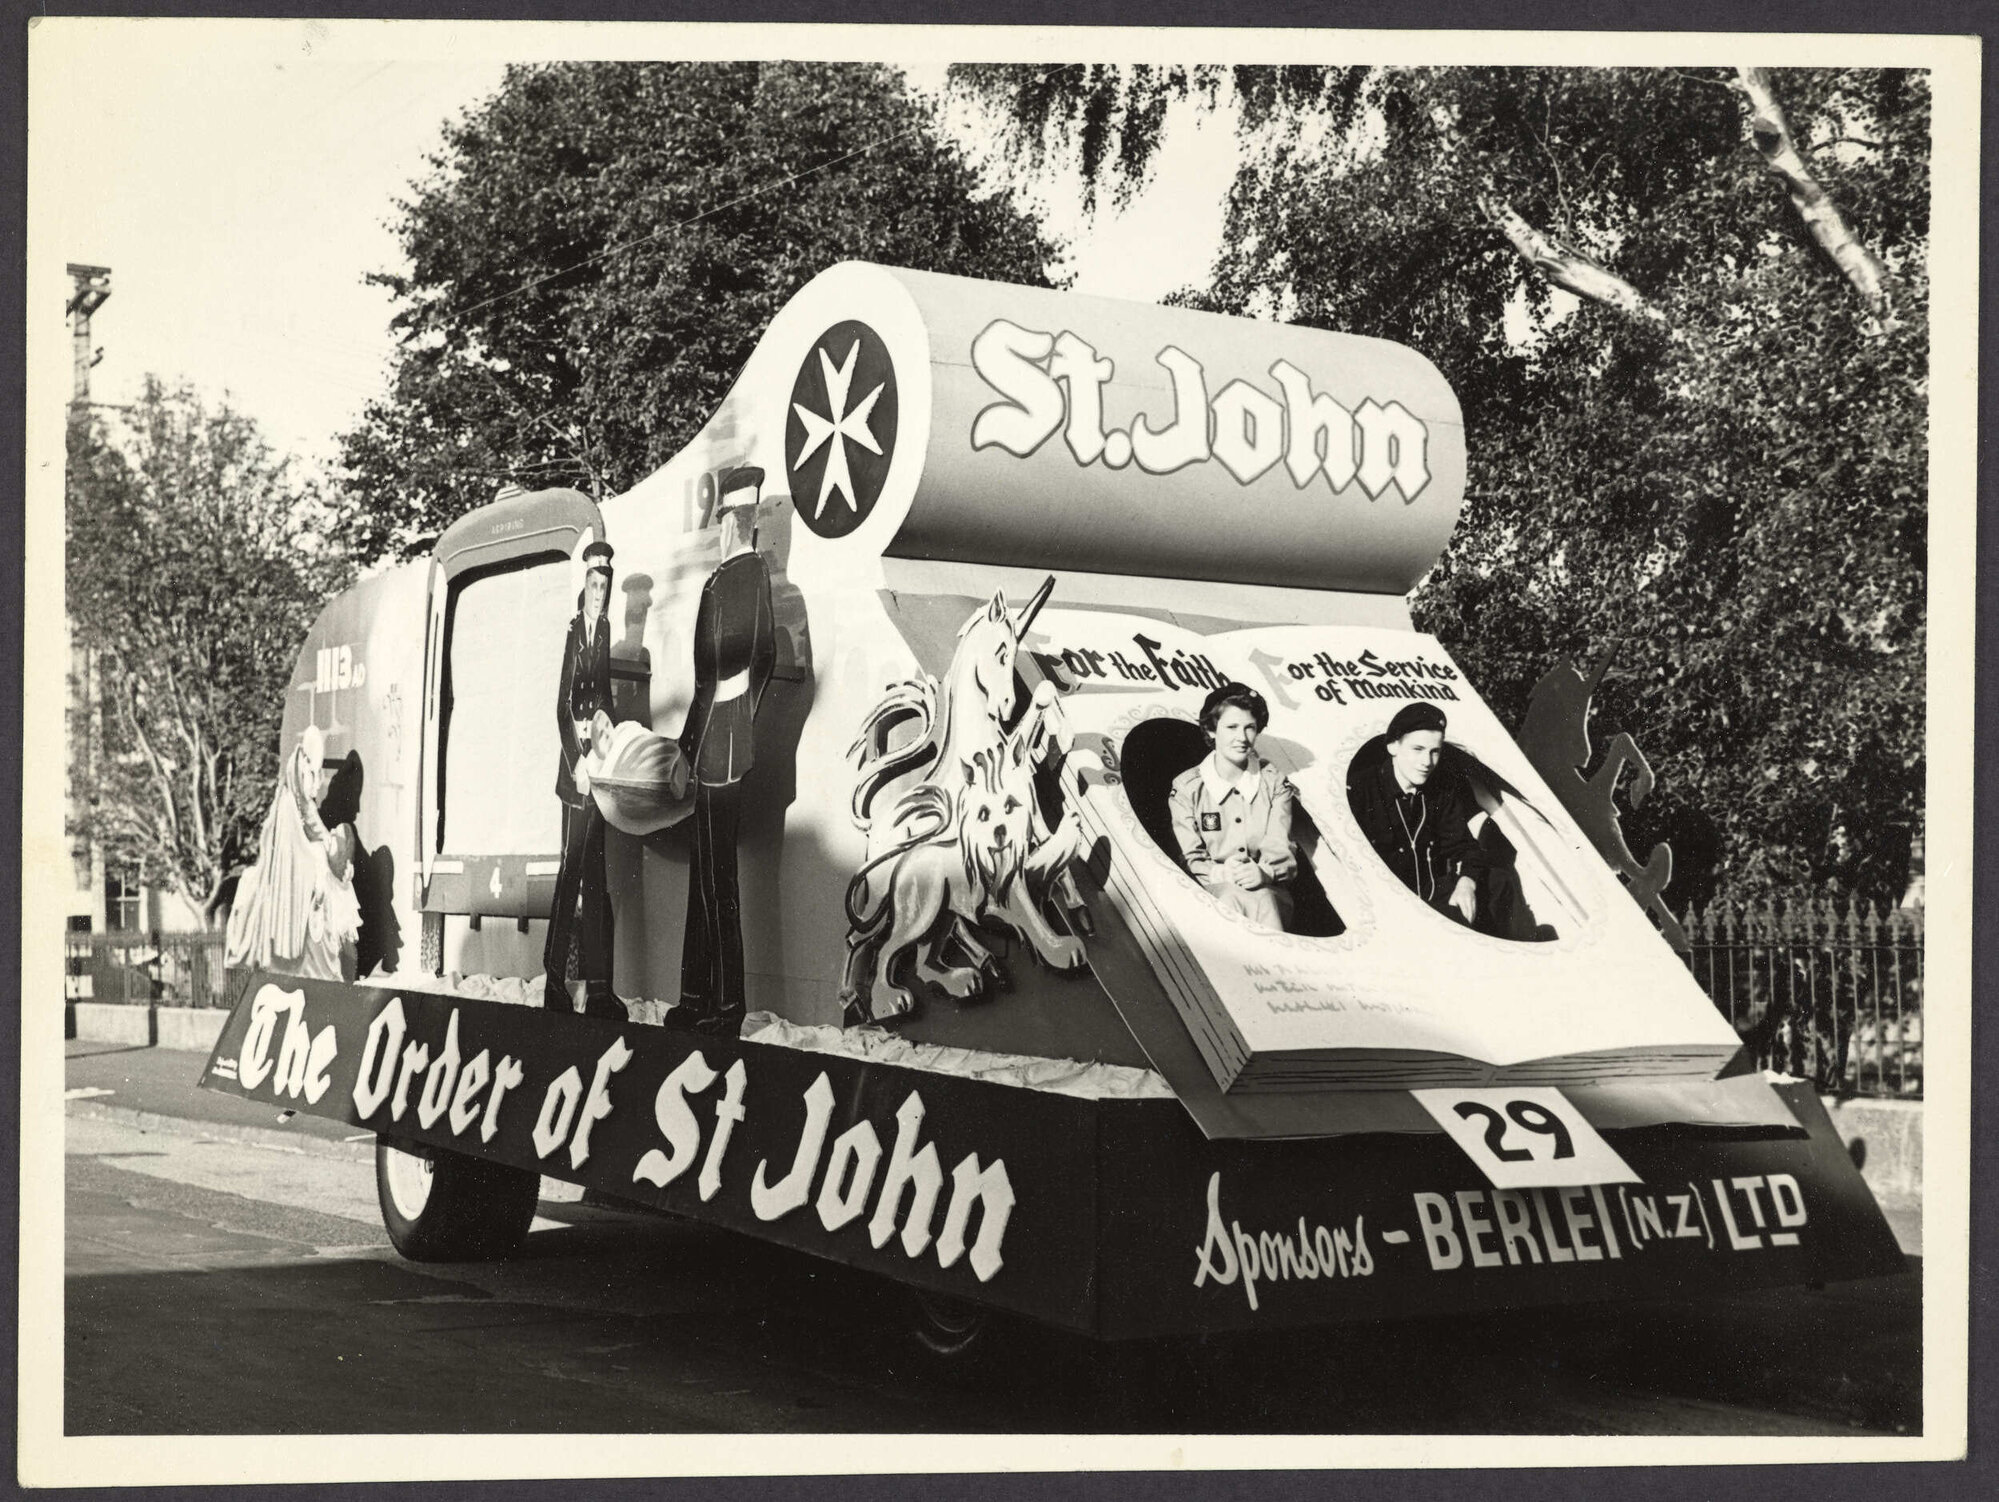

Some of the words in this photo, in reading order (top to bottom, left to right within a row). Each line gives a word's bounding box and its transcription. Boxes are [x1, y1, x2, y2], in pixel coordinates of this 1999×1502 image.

[1107, 650, 1158, 681] the
[1132, 632, 1233, 691] Faith
[1312, 651, 1362, 678] the
[1358, 648, 1459, 681] Service
[1314, 679, 1348, 706] of
[1343, 677, 1461, 702] Mankind
[489, 866, 503, 899] 4
[239, 983, 338, 1105] The
[352, 996, 524, 1144] Order
[532, 1035, 634, 1170] of
[632, 1049, 748, 1202] St
[751, 1070, 1016, 1283] John
[1452, 1100, 1576, 1163] 29
[1193, 1171, 1375, 1311] Sponsors
[1413, 1184, 1623, 1272] BERLEI
[1618, 1181, 1715, 1251] (N.Z)
[1711, 1173, 1808, 1251] LTD
